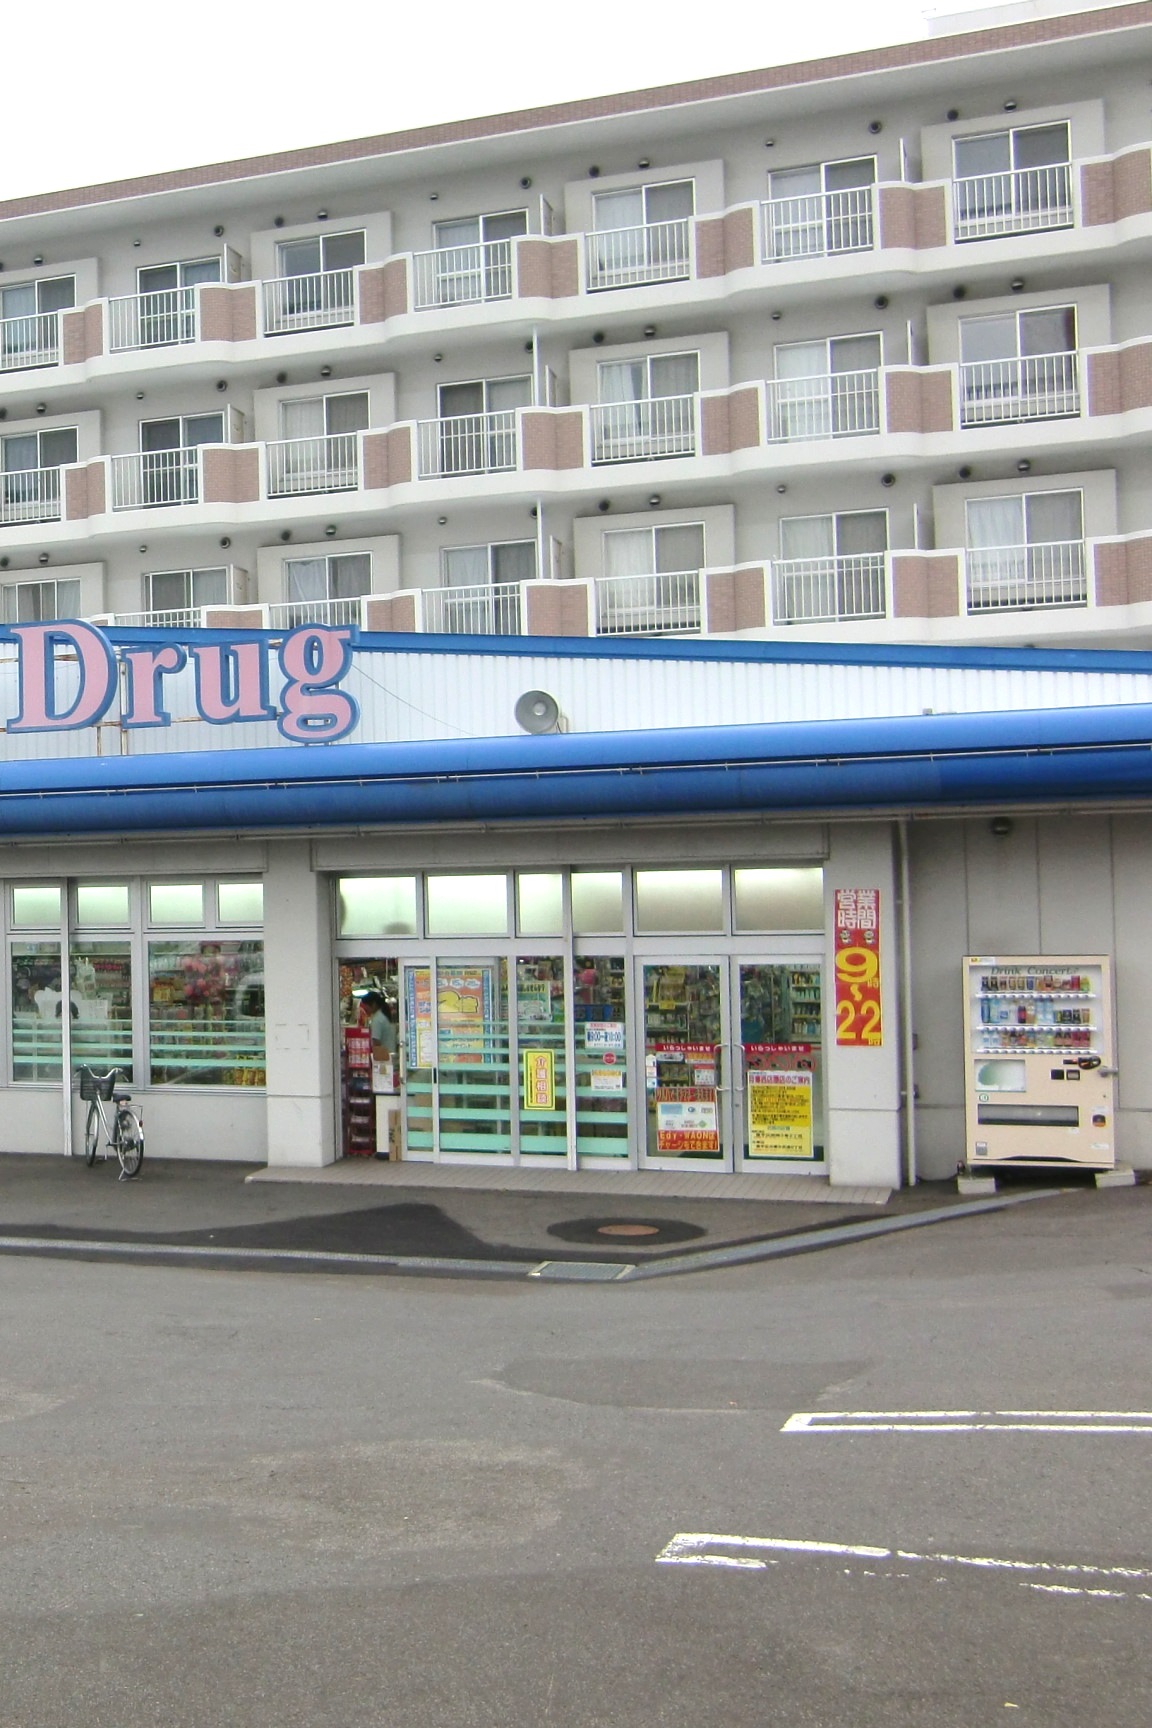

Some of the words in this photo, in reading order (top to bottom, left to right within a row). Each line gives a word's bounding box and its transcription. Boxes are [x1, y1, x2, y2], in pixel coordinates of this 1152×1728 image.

[6, 618, 361, 743] Drug
[837, 889, 877, 910] 営業
[837, 910, 877, 929] 時間
[991, 966, 1021, 975] Drink
[663, 1044, 711, 1052] いらっしゃいませ
[750, 1044, 805, 1052] いらっしゃいませ
